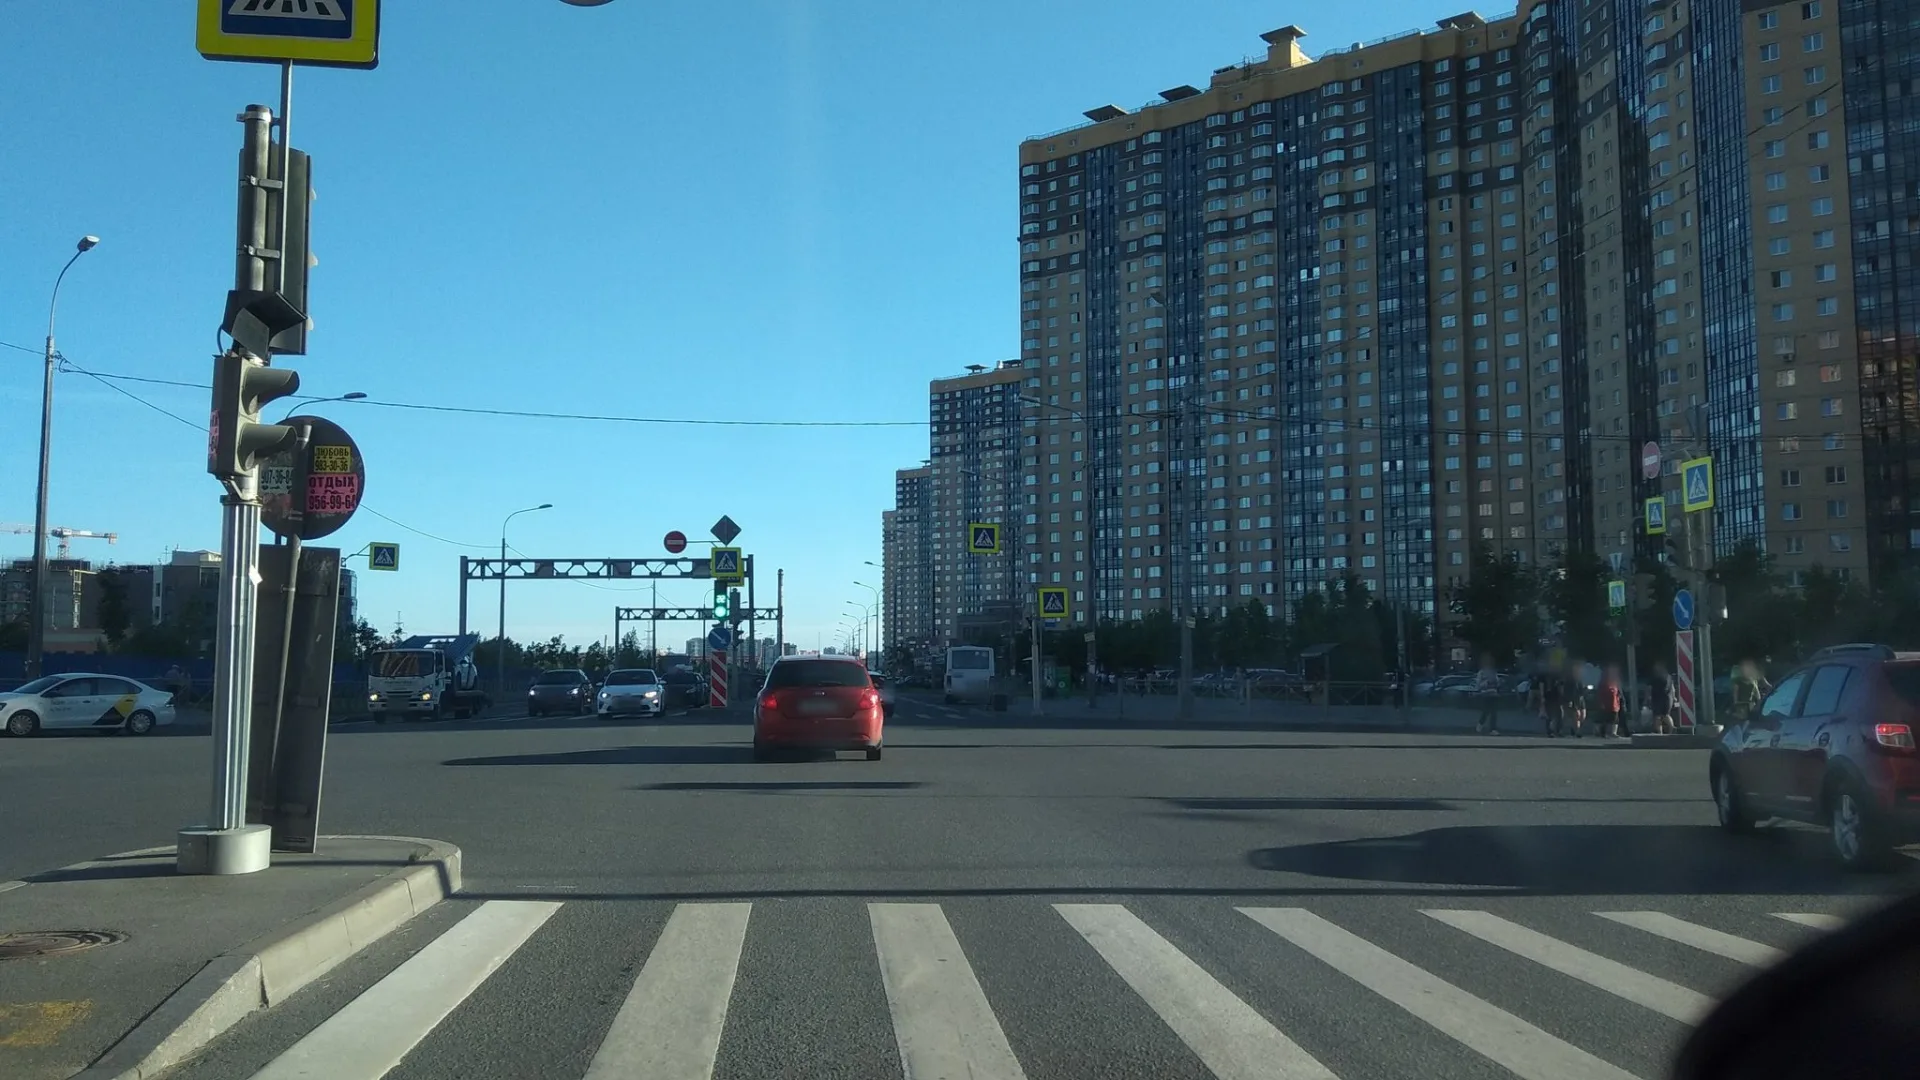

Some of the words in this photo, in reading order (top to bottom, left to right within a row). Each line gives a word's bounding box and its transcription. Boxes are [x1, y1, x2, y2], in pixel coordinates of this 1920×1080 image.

[314, 447, 349, 457] ЛЮБОВЬ
[315, 460, 348, 471] 983-30-36
[309, 476, 355, 489] ОТДЫХ
